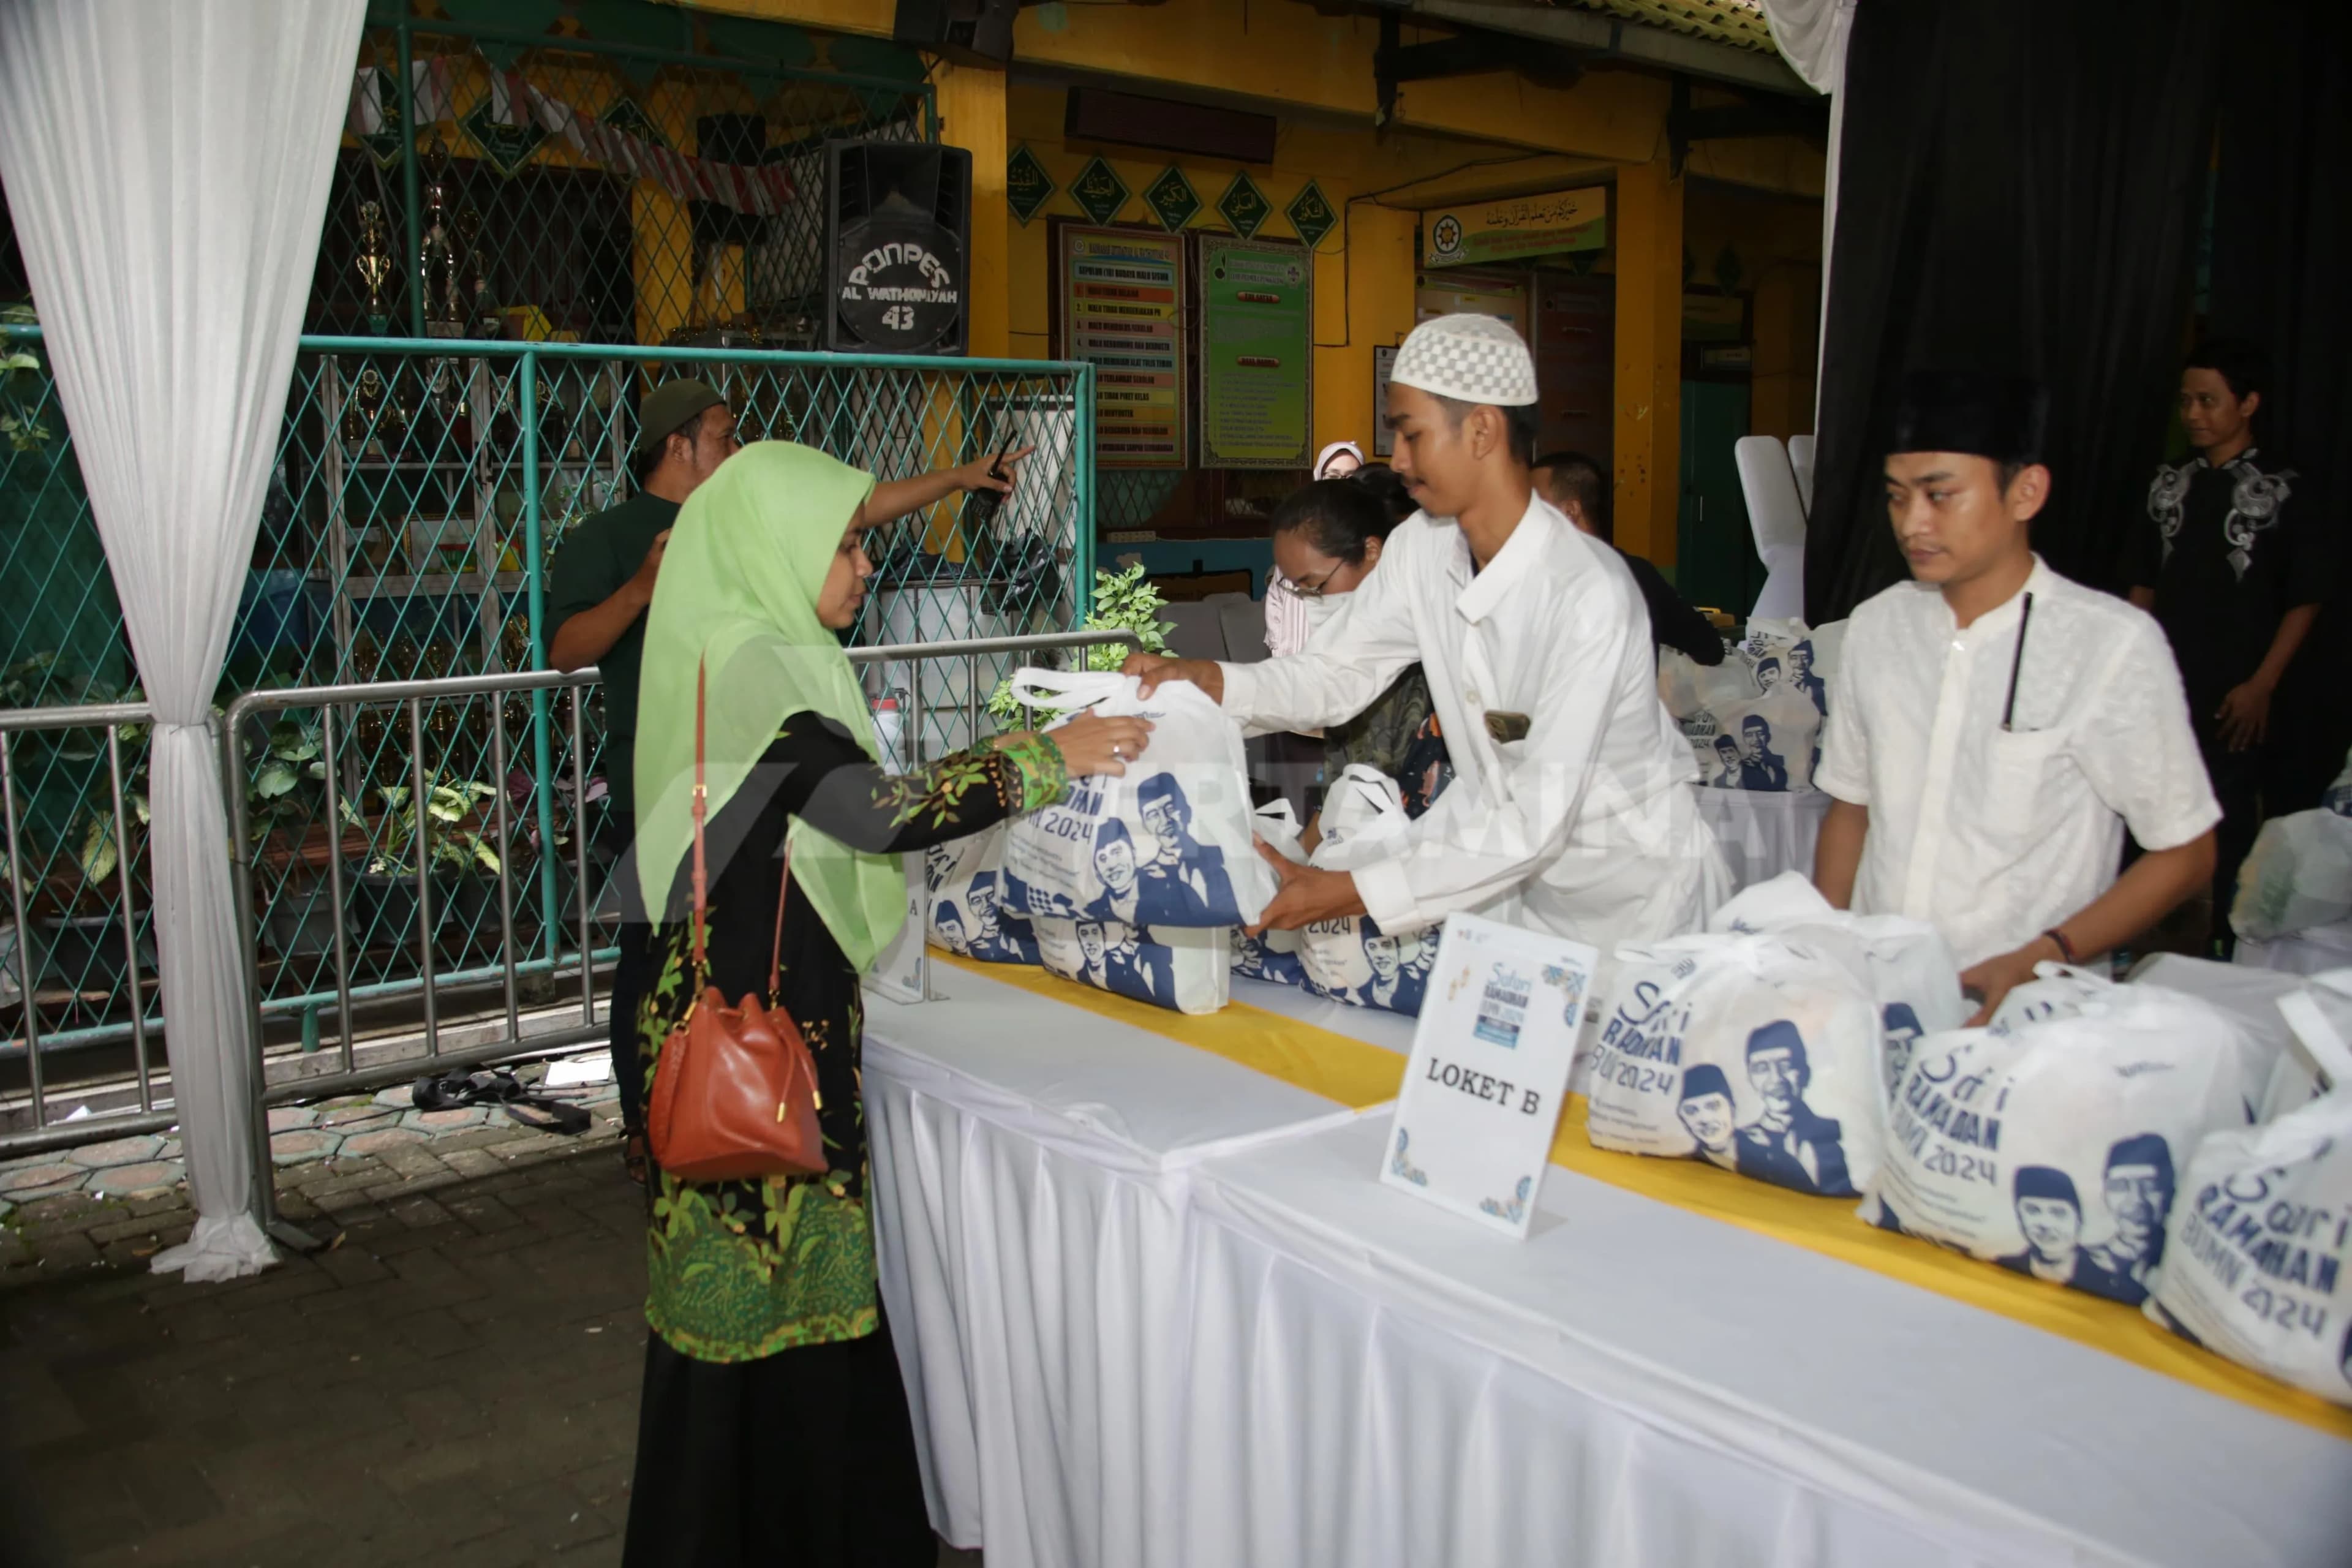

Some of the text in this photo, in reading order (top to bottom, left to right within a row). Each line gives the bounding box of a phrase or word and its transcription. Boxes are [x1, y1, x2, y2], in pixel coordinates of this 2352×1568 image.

[848, 243, 950, 288] PONPES
[842, 286, 957, 303] AL WATHONIYAH
[882, 306, 914, 330] 43
[1044, 812, 1094, 845] 2024
[910, 899, 918, 916] A
[1427, 1057, 1540, 1115] LOKET B
[1617, 1061, 1674, 1095] 2024
[1924, 1144, 1997, 1186] 2024
